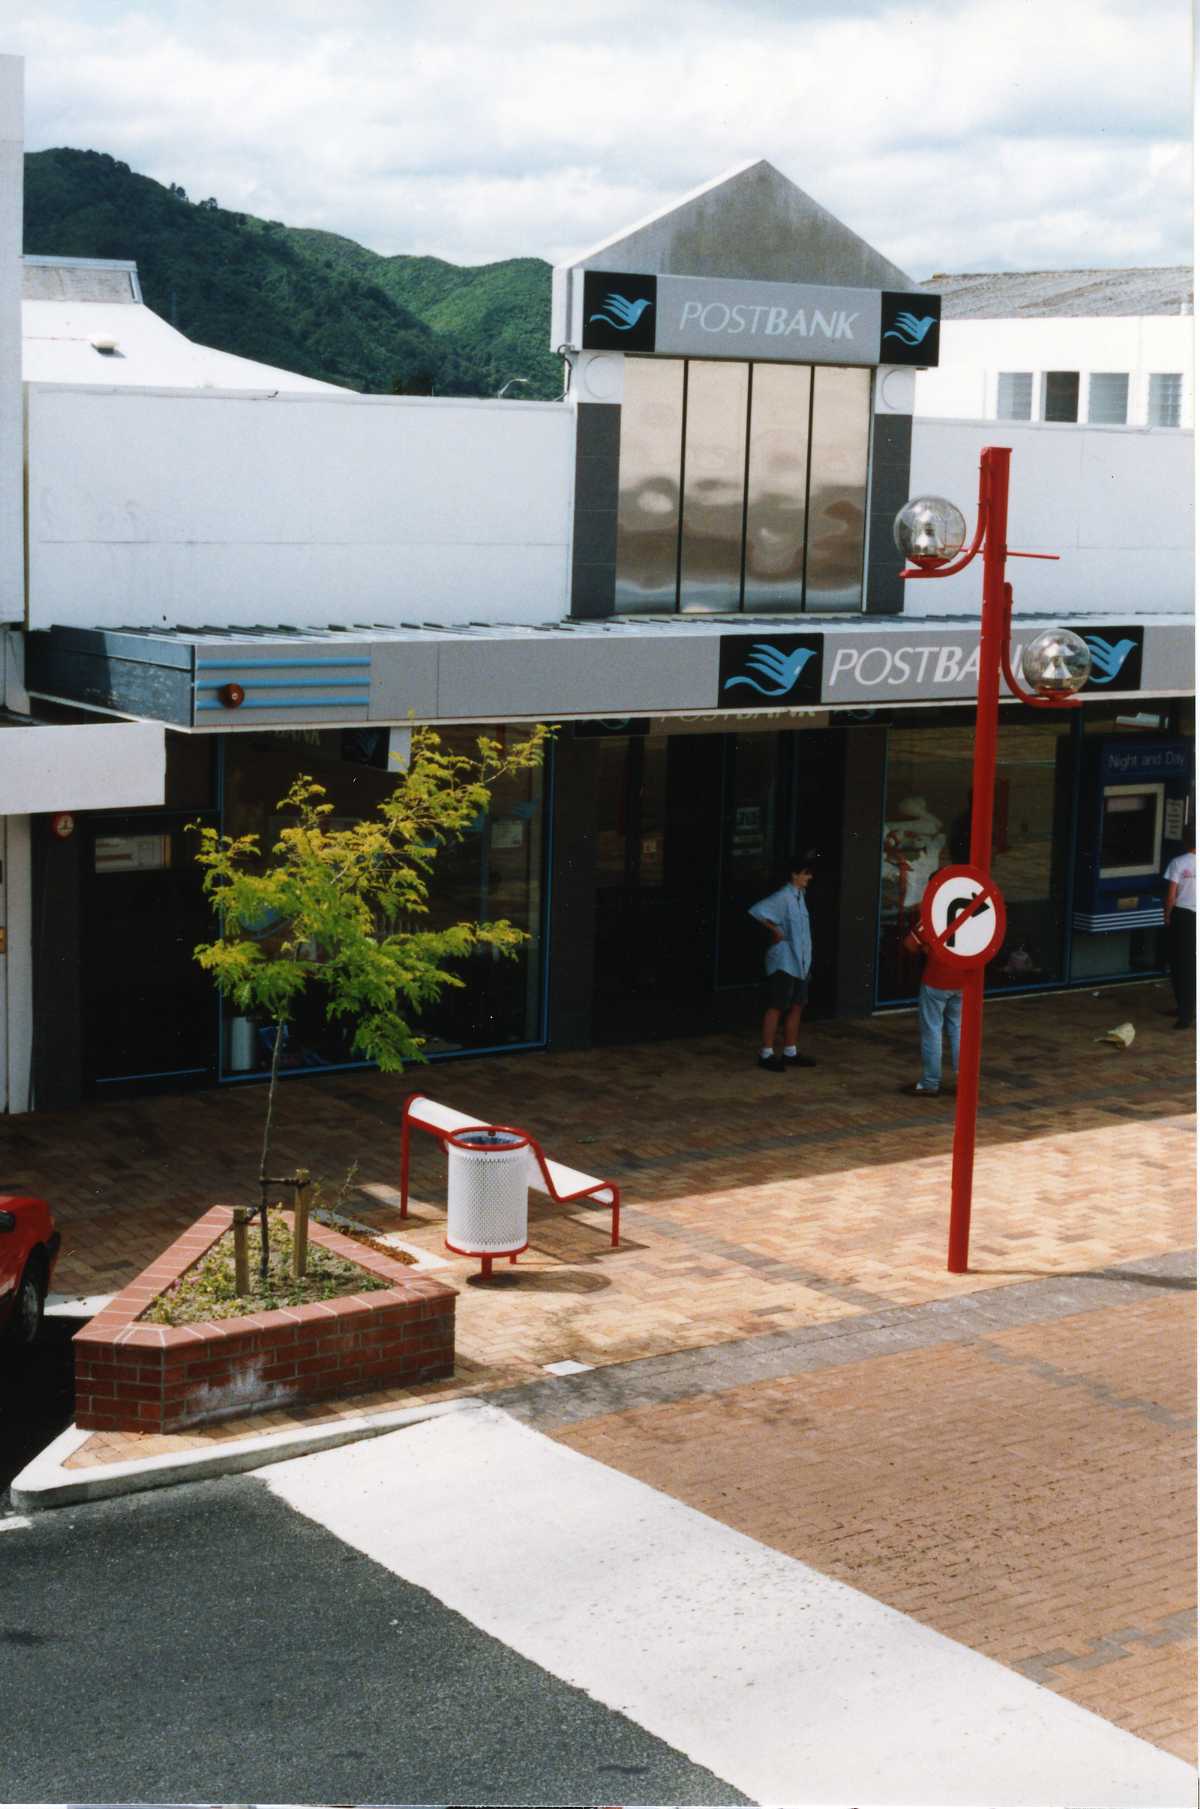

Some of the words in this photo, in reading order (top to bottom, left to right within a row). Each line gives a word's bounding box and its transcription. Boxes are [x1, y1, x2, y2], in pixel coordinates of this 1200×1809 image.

[679, 301, 861, 339] POSTBANK
[828, 645, 1027, 686] POSTBA
[1107, 753, 1137, 769] Night
[1141, 752, 1161, 766] and
